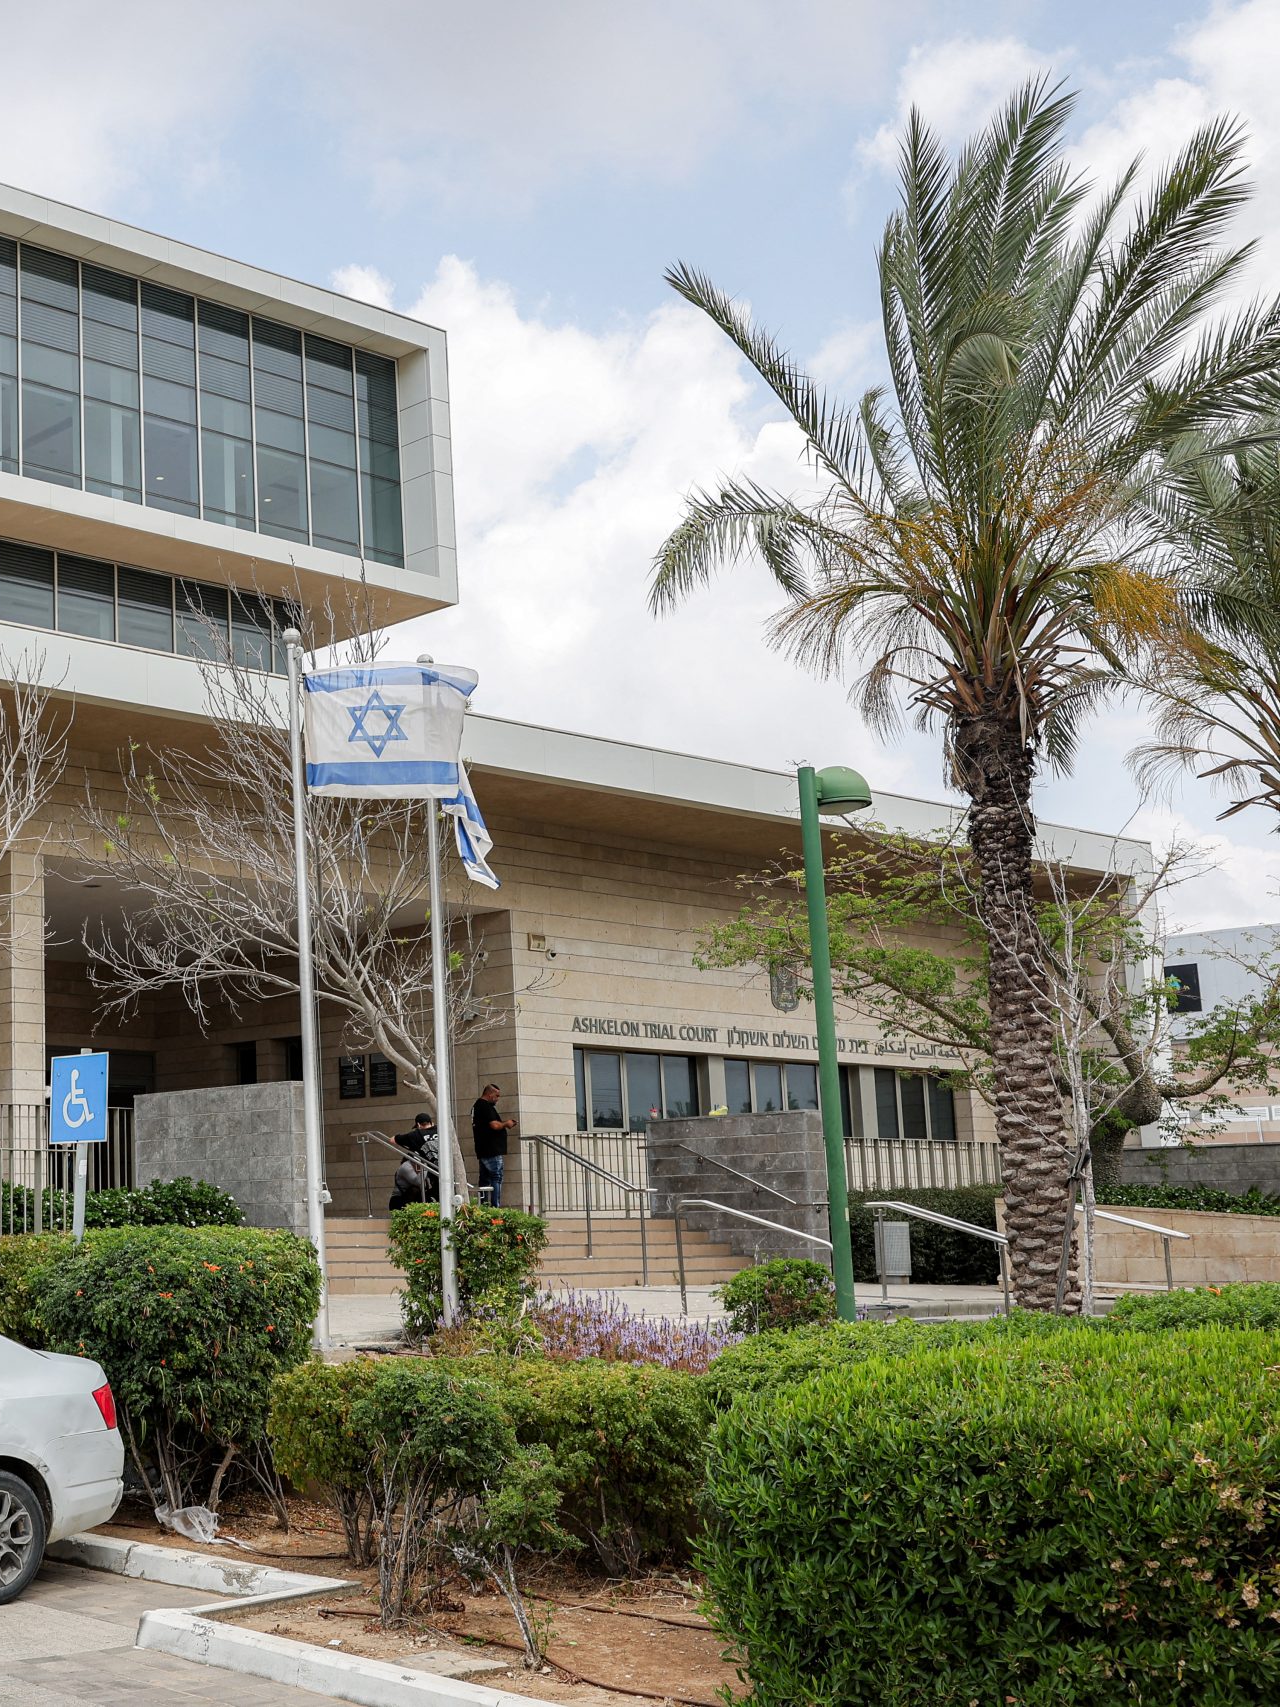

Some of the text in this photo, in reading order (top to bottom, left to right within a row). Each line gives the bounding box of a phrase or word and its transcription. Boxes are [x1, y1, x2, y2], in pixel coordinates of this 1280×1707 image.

[572, 1016, 718, 1042] ASHKELON TRIAL COURT
[727, 1026, 770, 1048] אשקלון
[773, 1030, 809, 1050] השלום
